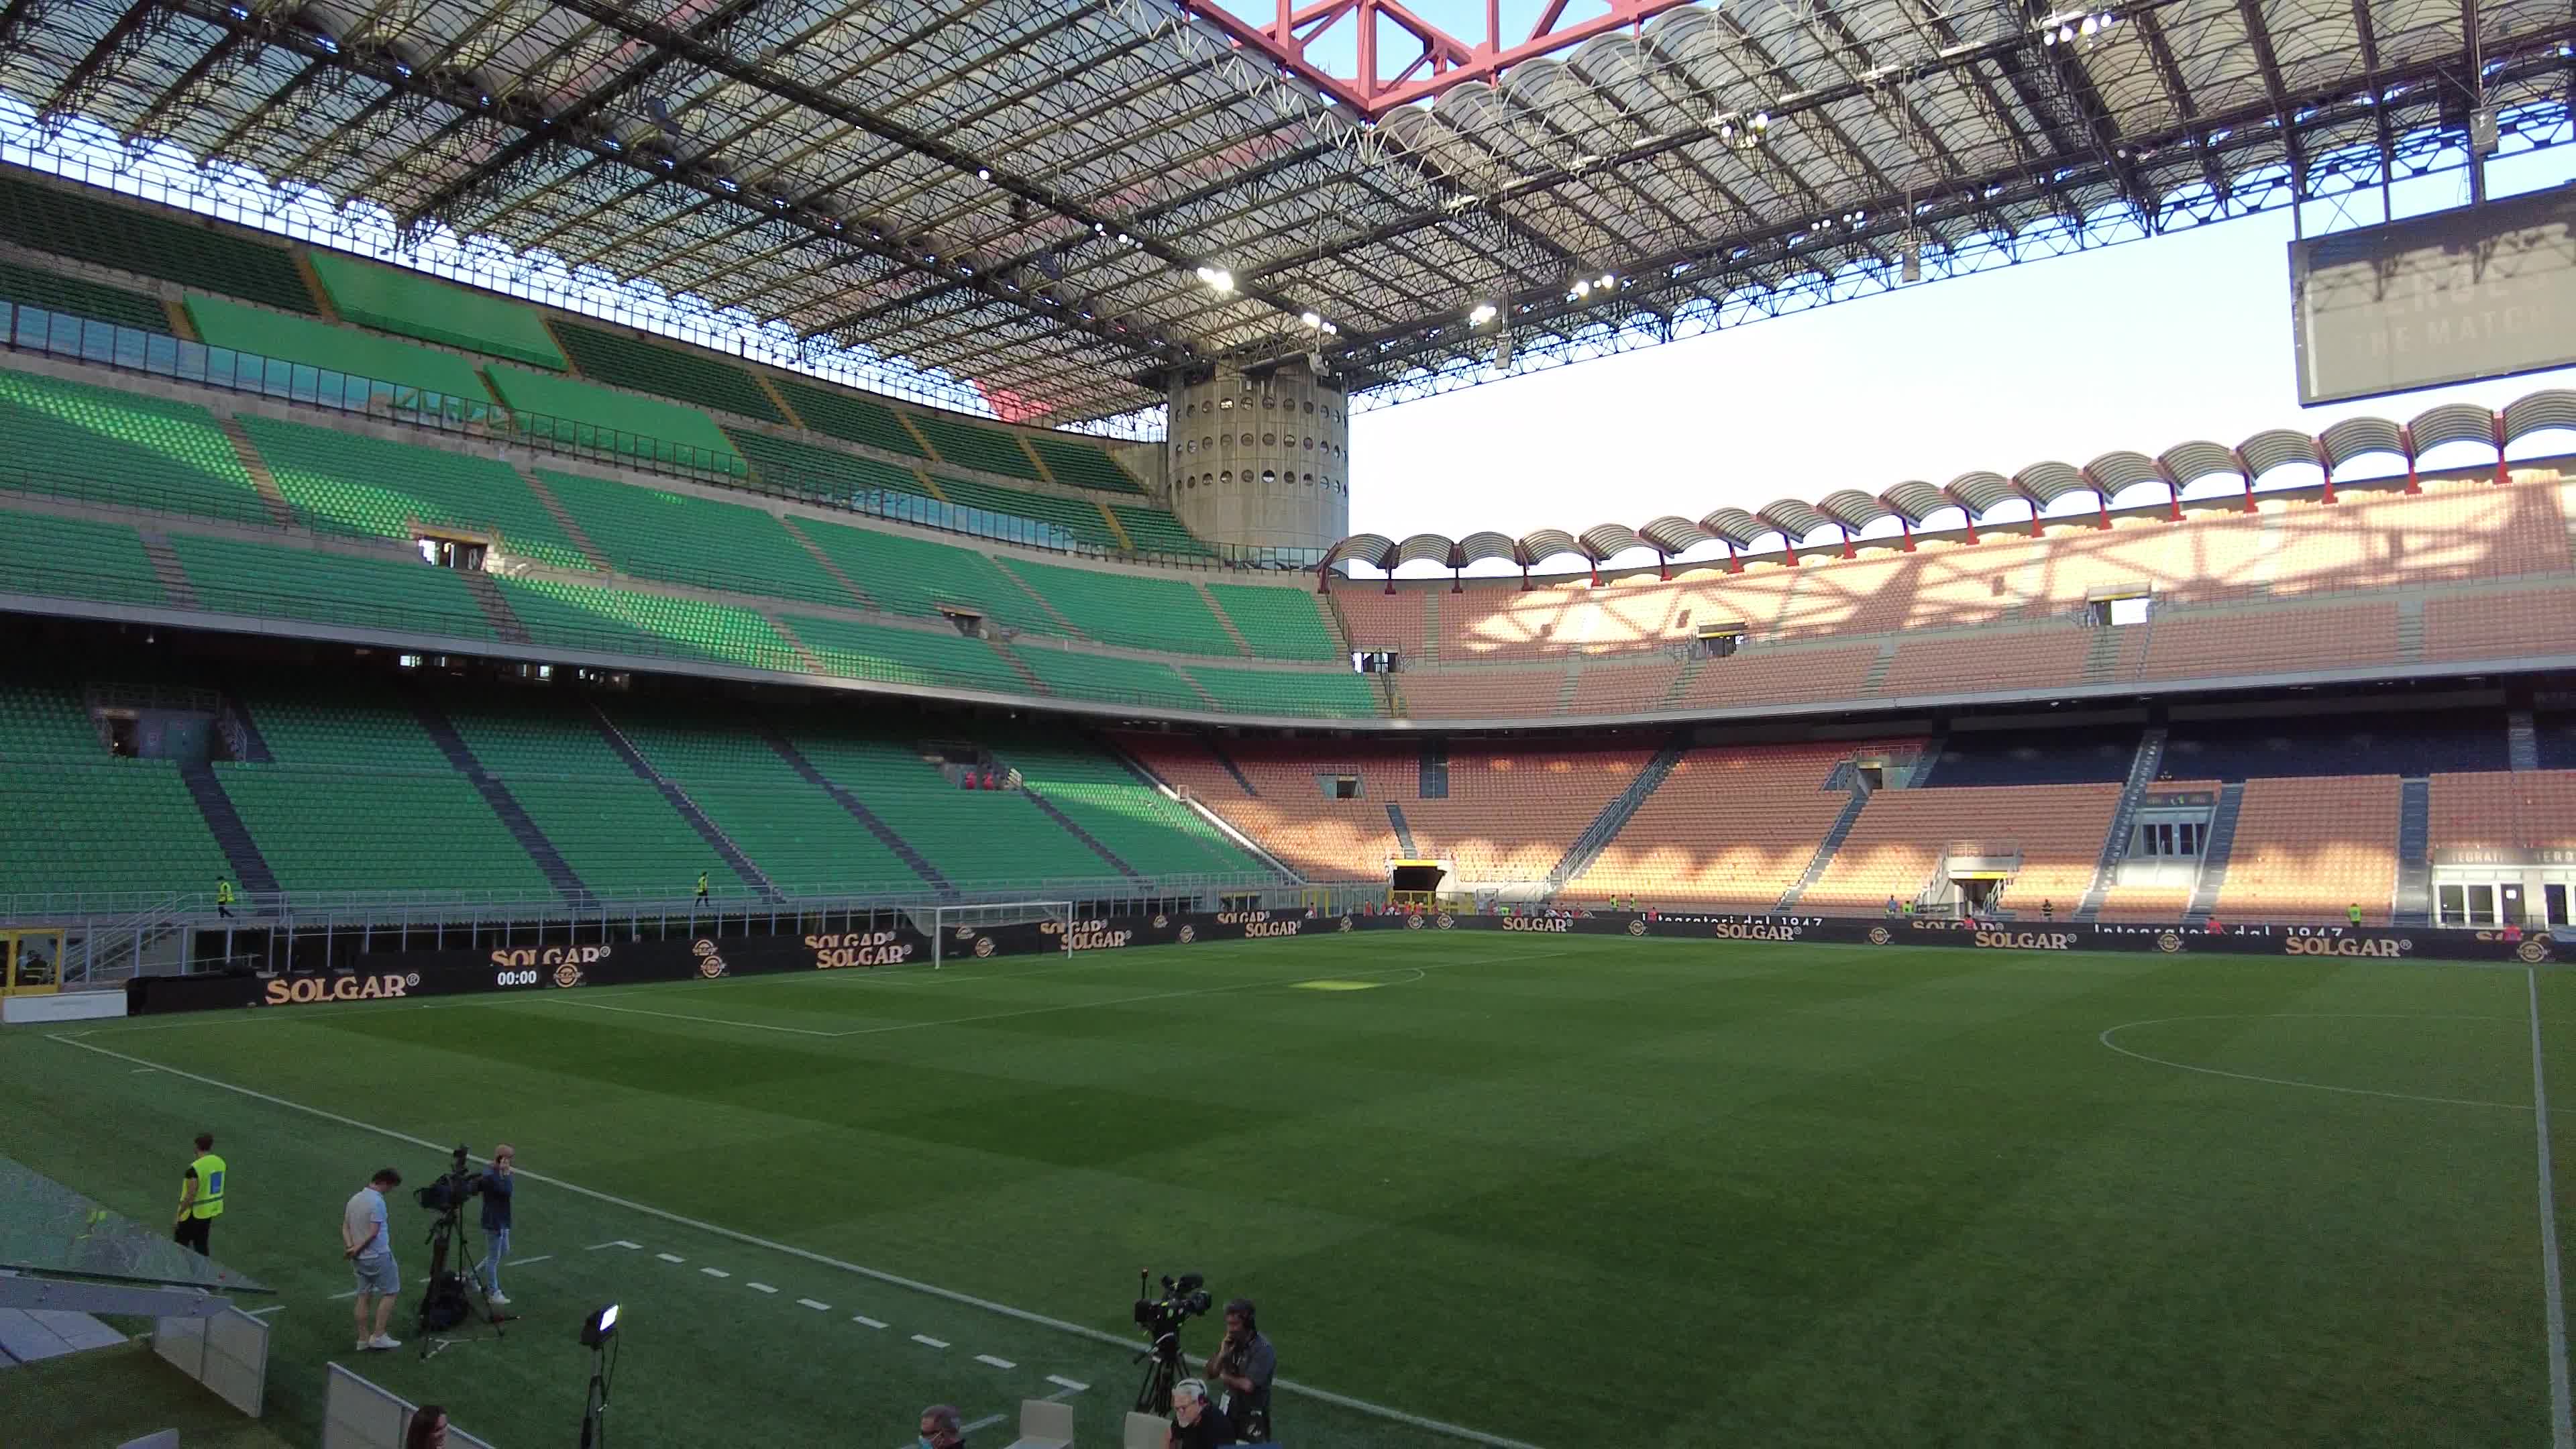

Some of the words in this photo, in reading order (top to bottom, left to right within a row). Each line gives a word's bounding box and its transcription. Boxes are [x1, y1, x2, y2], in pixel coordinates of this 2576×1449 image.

[2354, 327, 2410, 356] THE
[2427, 305, 2551, 344] MATCH
[497, 970, 537, 986] 00:00
